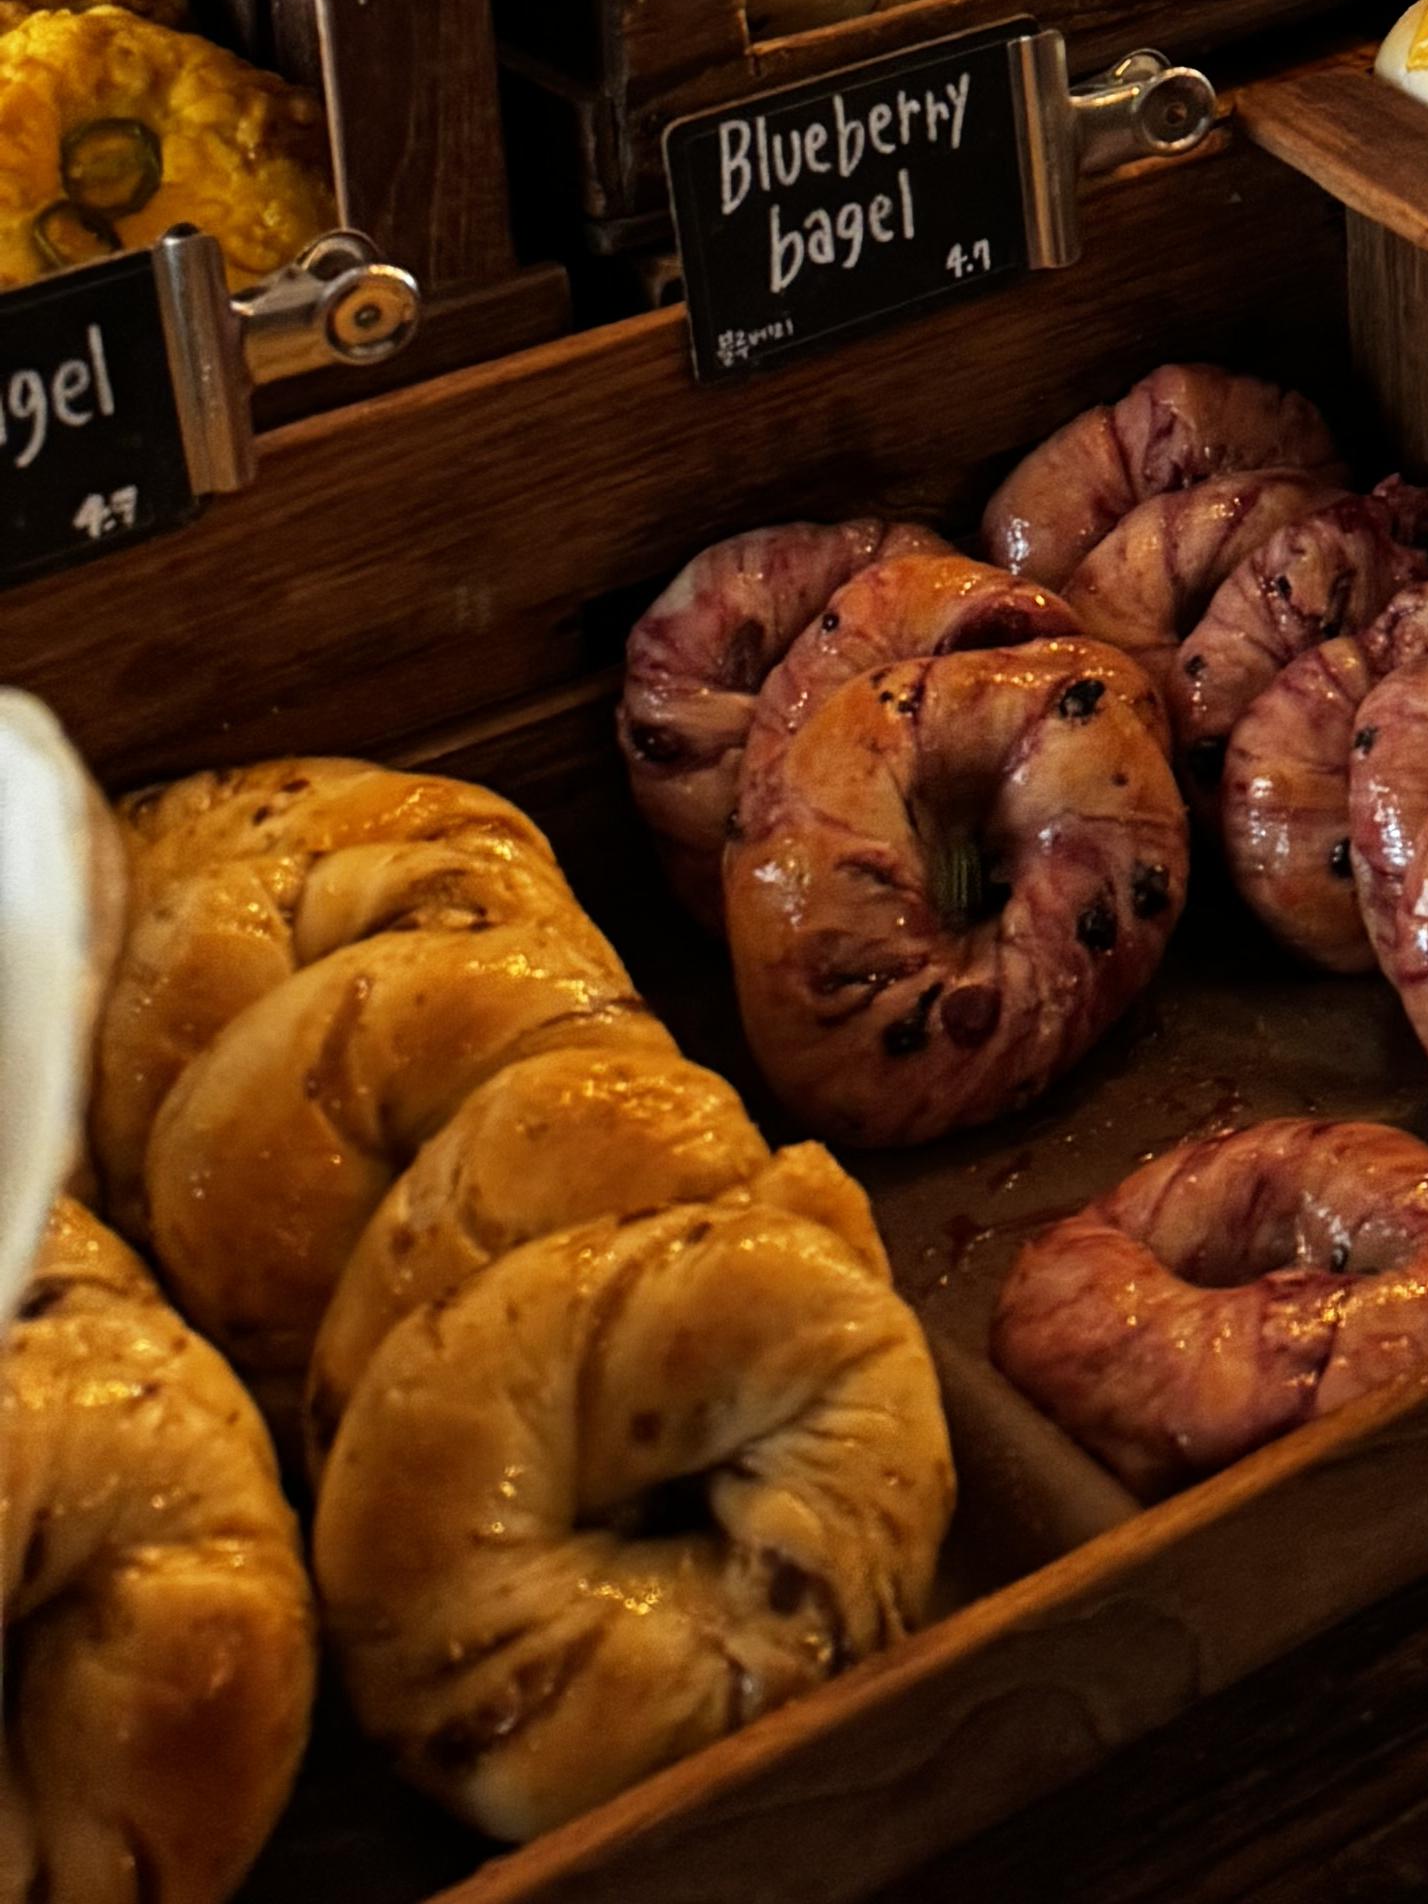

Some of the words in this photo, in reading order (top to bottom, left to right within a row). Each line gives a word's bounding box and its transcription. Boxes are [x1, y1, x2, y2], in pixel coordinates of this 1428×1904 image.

[719, 72, 970, 215] Blueberry
[770, 168, 915, 293] bagel
[945, 238, 991, 278] 4.7
[0, 323, 115, 469] gel
